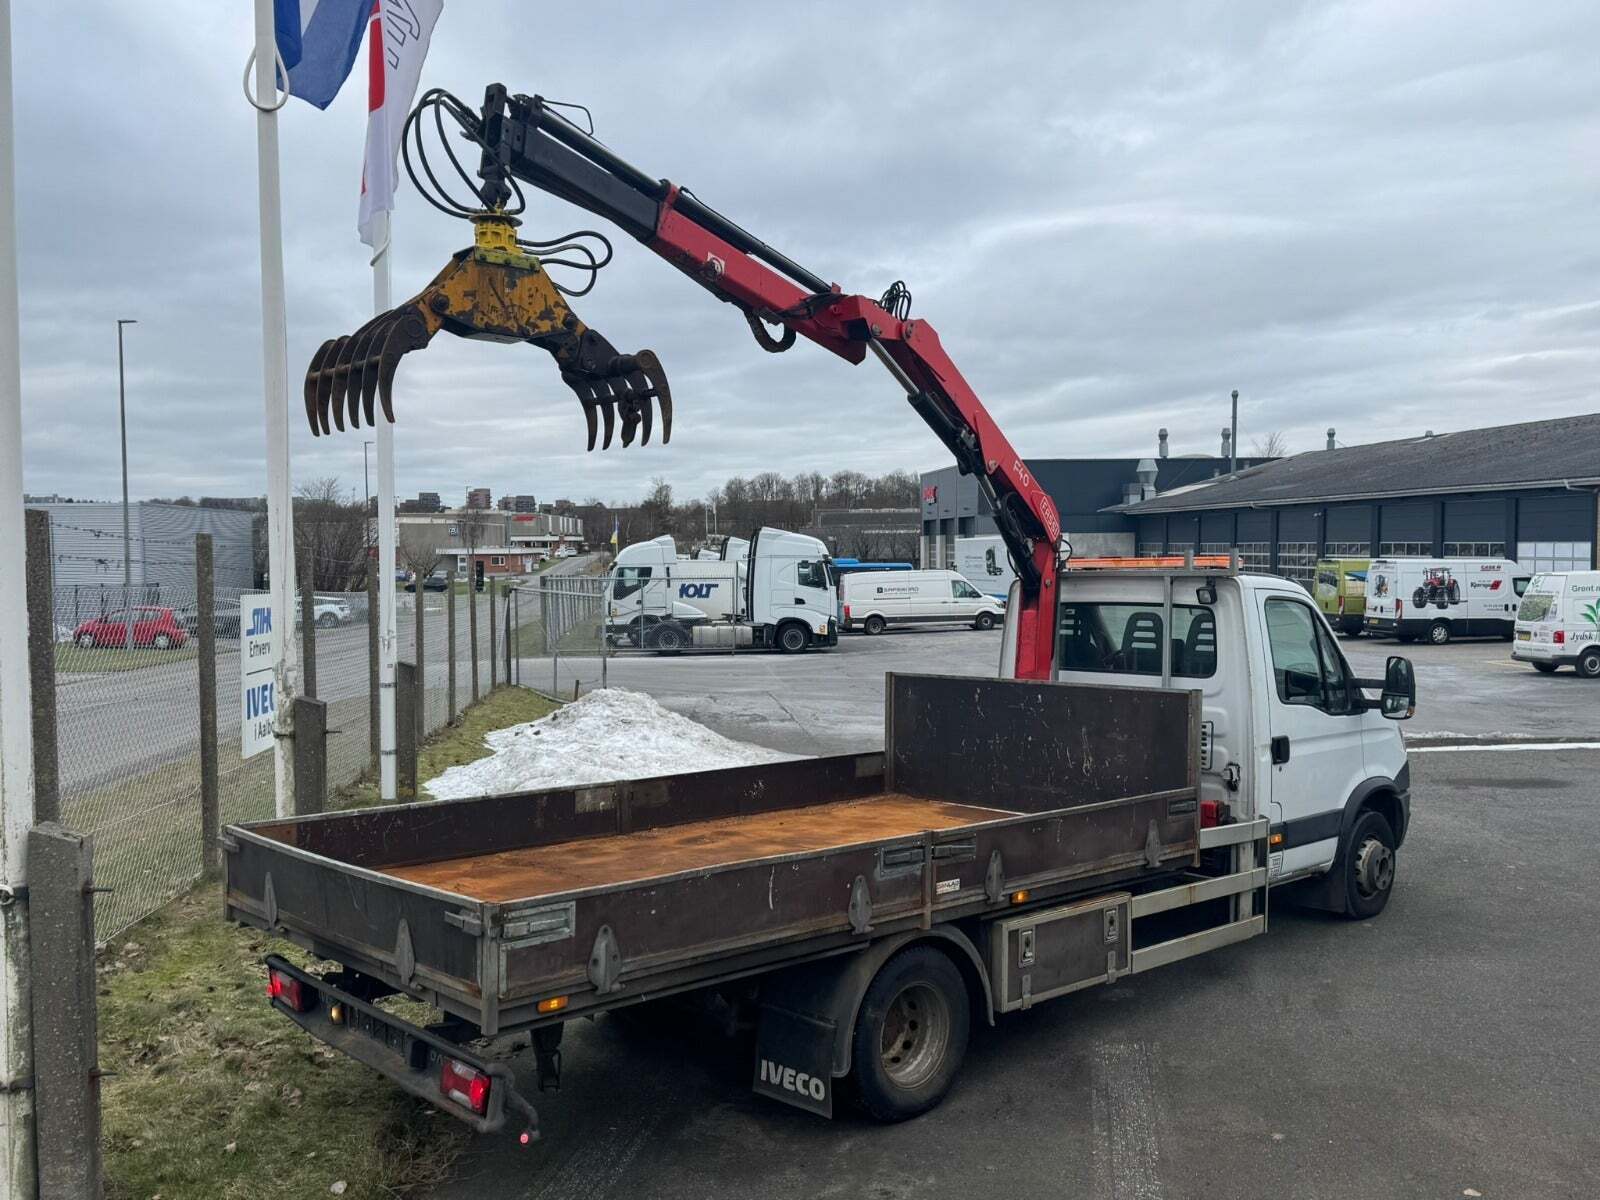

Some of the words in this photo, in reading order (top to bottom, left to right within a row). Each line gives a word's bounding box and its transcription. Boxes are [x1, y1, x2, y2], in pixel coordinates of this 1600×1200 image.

[1013, 460, 1029, 487] F40
[247, 682, 274, 720] IVEC
[258, 719, 274, 738] Aalb
[760, 1059, 825, 1101] IVECO
